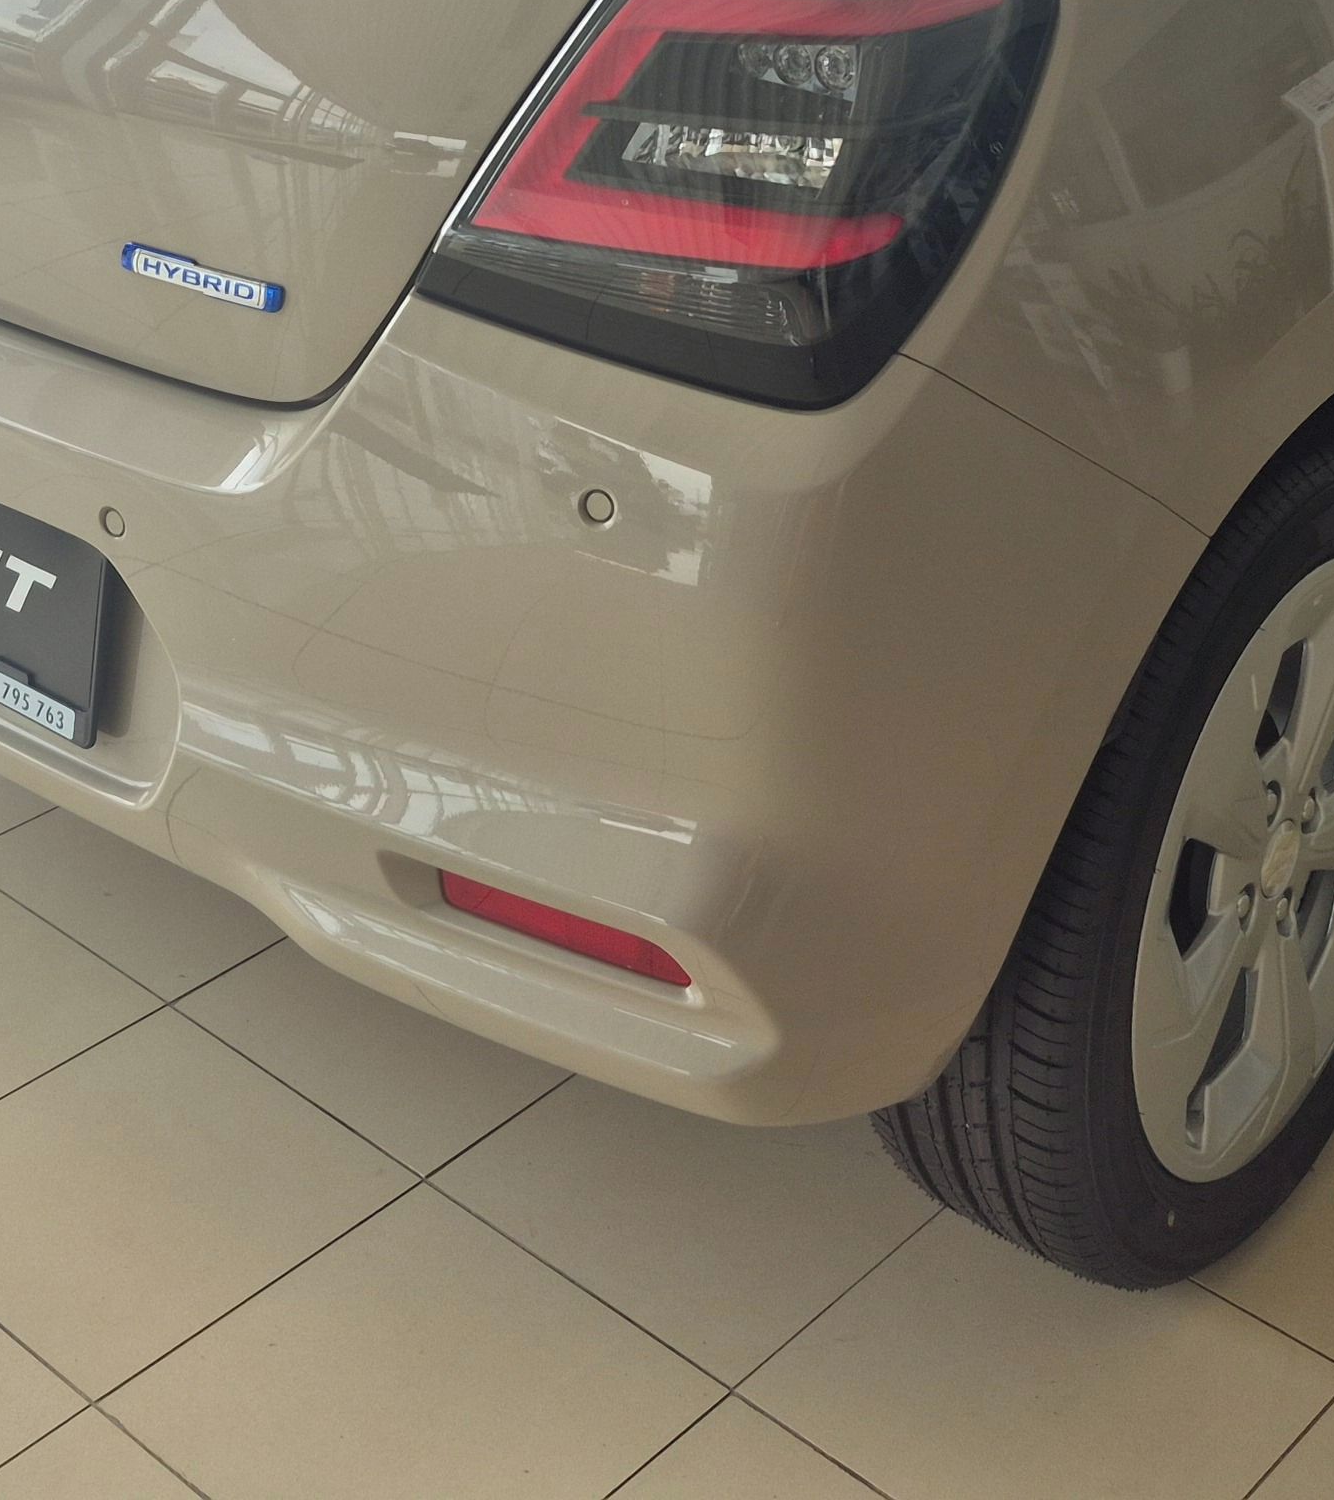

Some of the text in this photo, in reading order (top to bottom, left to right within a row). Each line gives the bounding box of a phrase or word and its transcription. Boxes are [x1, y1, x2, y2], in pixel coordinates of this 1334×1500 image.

[142, 257, 255, 300] HYBRID
[2, 681, 30, 712] 795
[35, 699, 65, 730] 763
